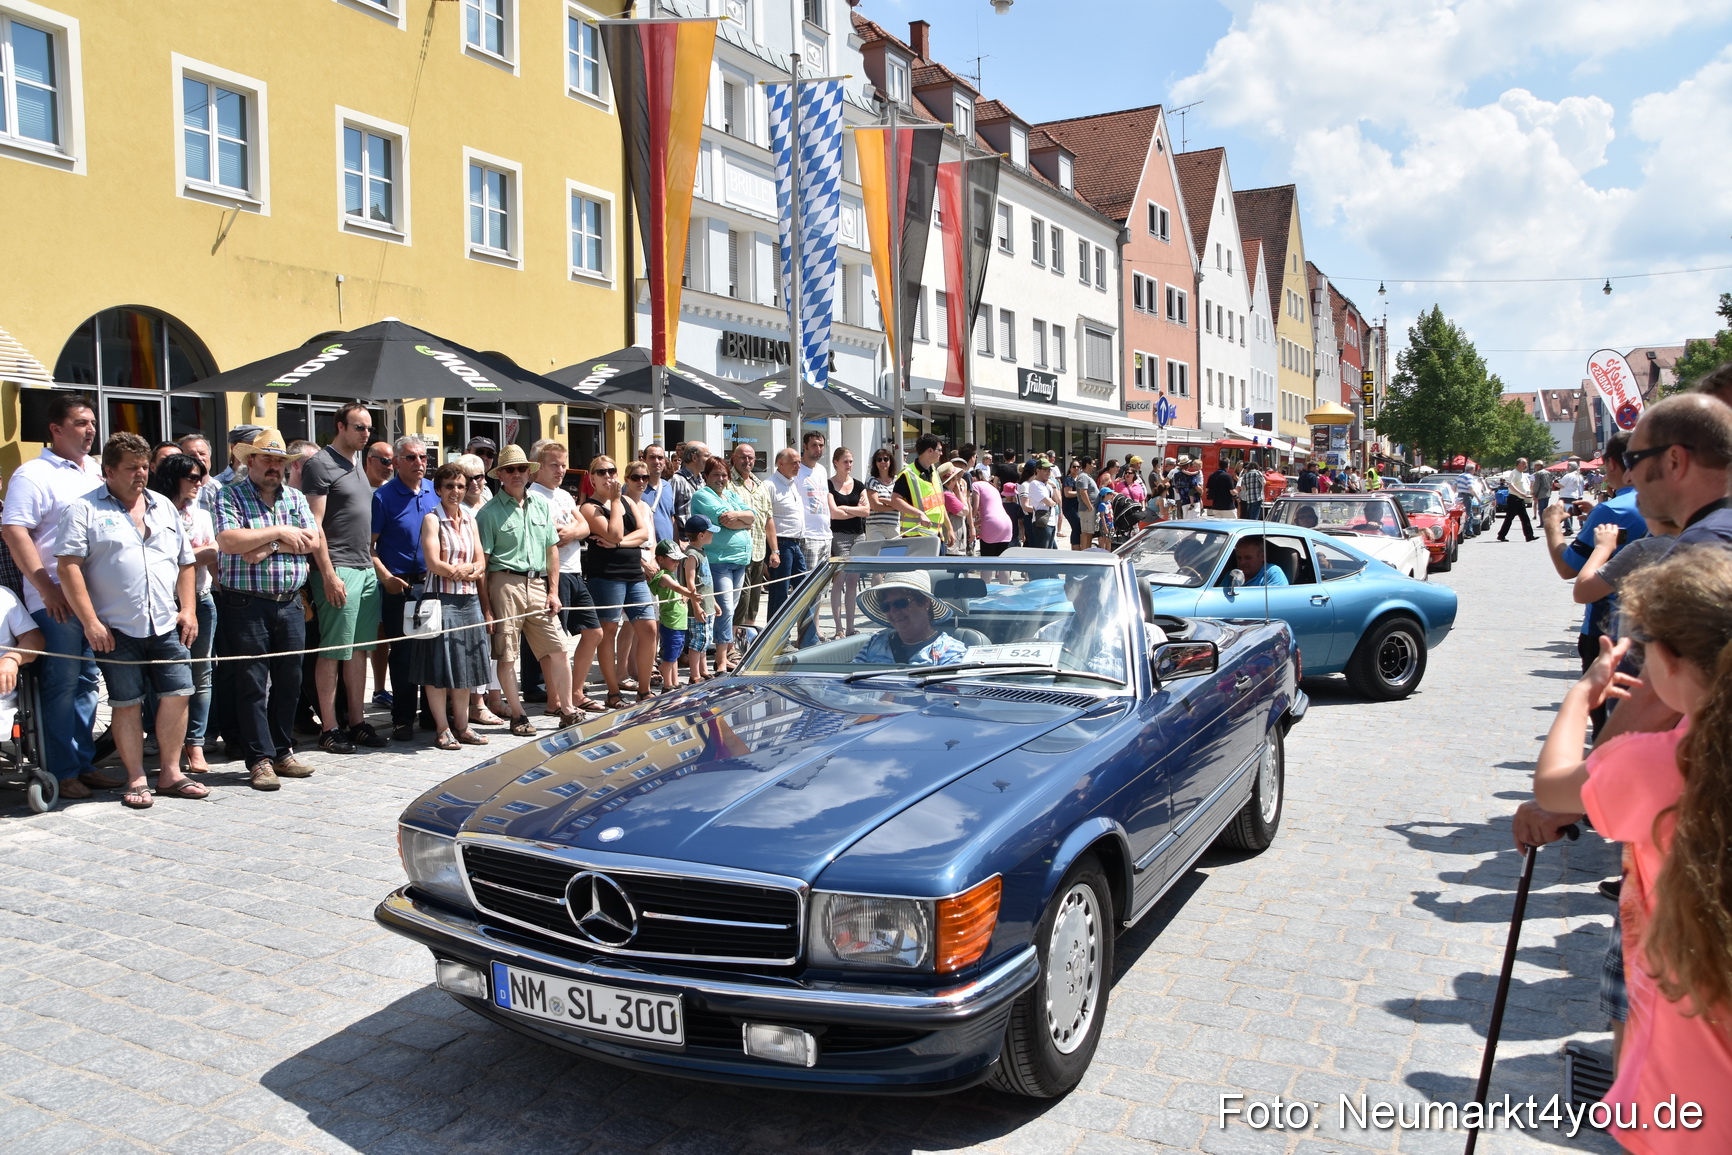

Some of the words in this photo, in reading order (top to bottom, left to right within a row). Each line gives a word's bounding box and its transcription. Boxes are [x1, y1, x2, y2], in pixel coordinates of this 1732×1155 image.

[272, 344, 349, 383] now
[416, 345, 498, 388] now
[1362, 371, 1373, 417] HOTE
[617, 421, 626, 432] 24
[1010, 649, 1041, 658] 524
[500, 990, 506, 1000] D
[510, 972, 547, 1013] NM
[567, 986, 607, 1025] SL
[615, 994, 677, 1035] 300
